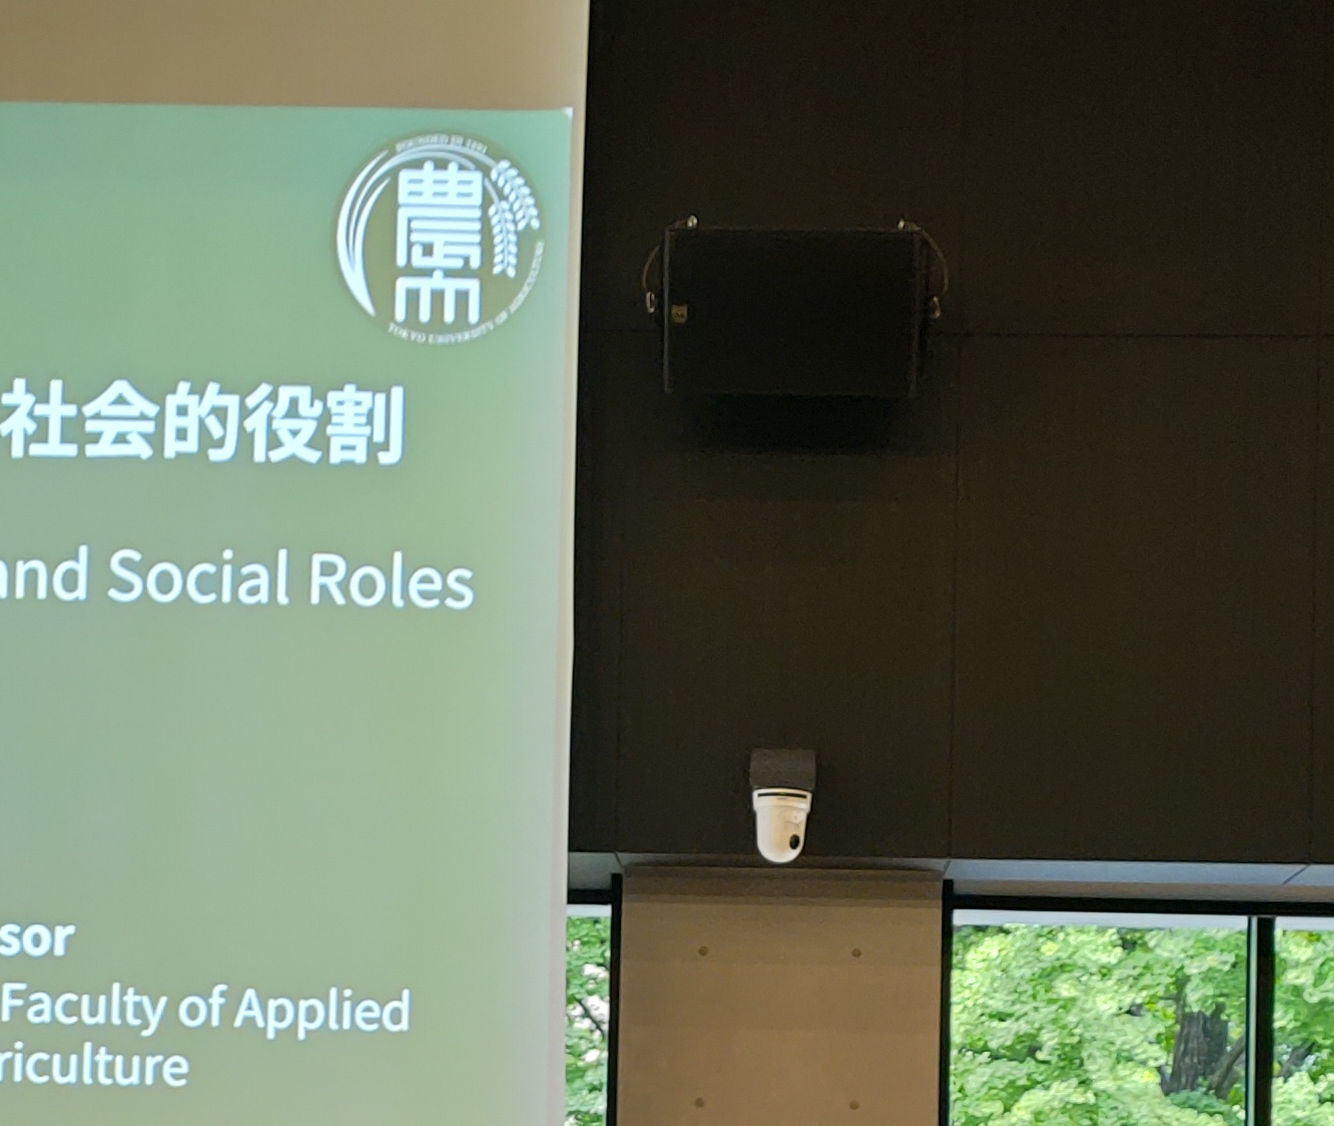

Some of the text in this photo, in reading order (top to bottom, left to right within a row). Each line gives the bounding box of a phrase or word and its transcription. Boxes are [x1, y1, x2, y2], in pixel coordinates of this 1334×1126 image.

[107, 548, 289, 605] Social
[310, 550, 473, 609] Roles
[1, 982, 168, 1037] Faculty
[178, 984, 228, 1027] of
[233, 987, 410, 1040] Applied
